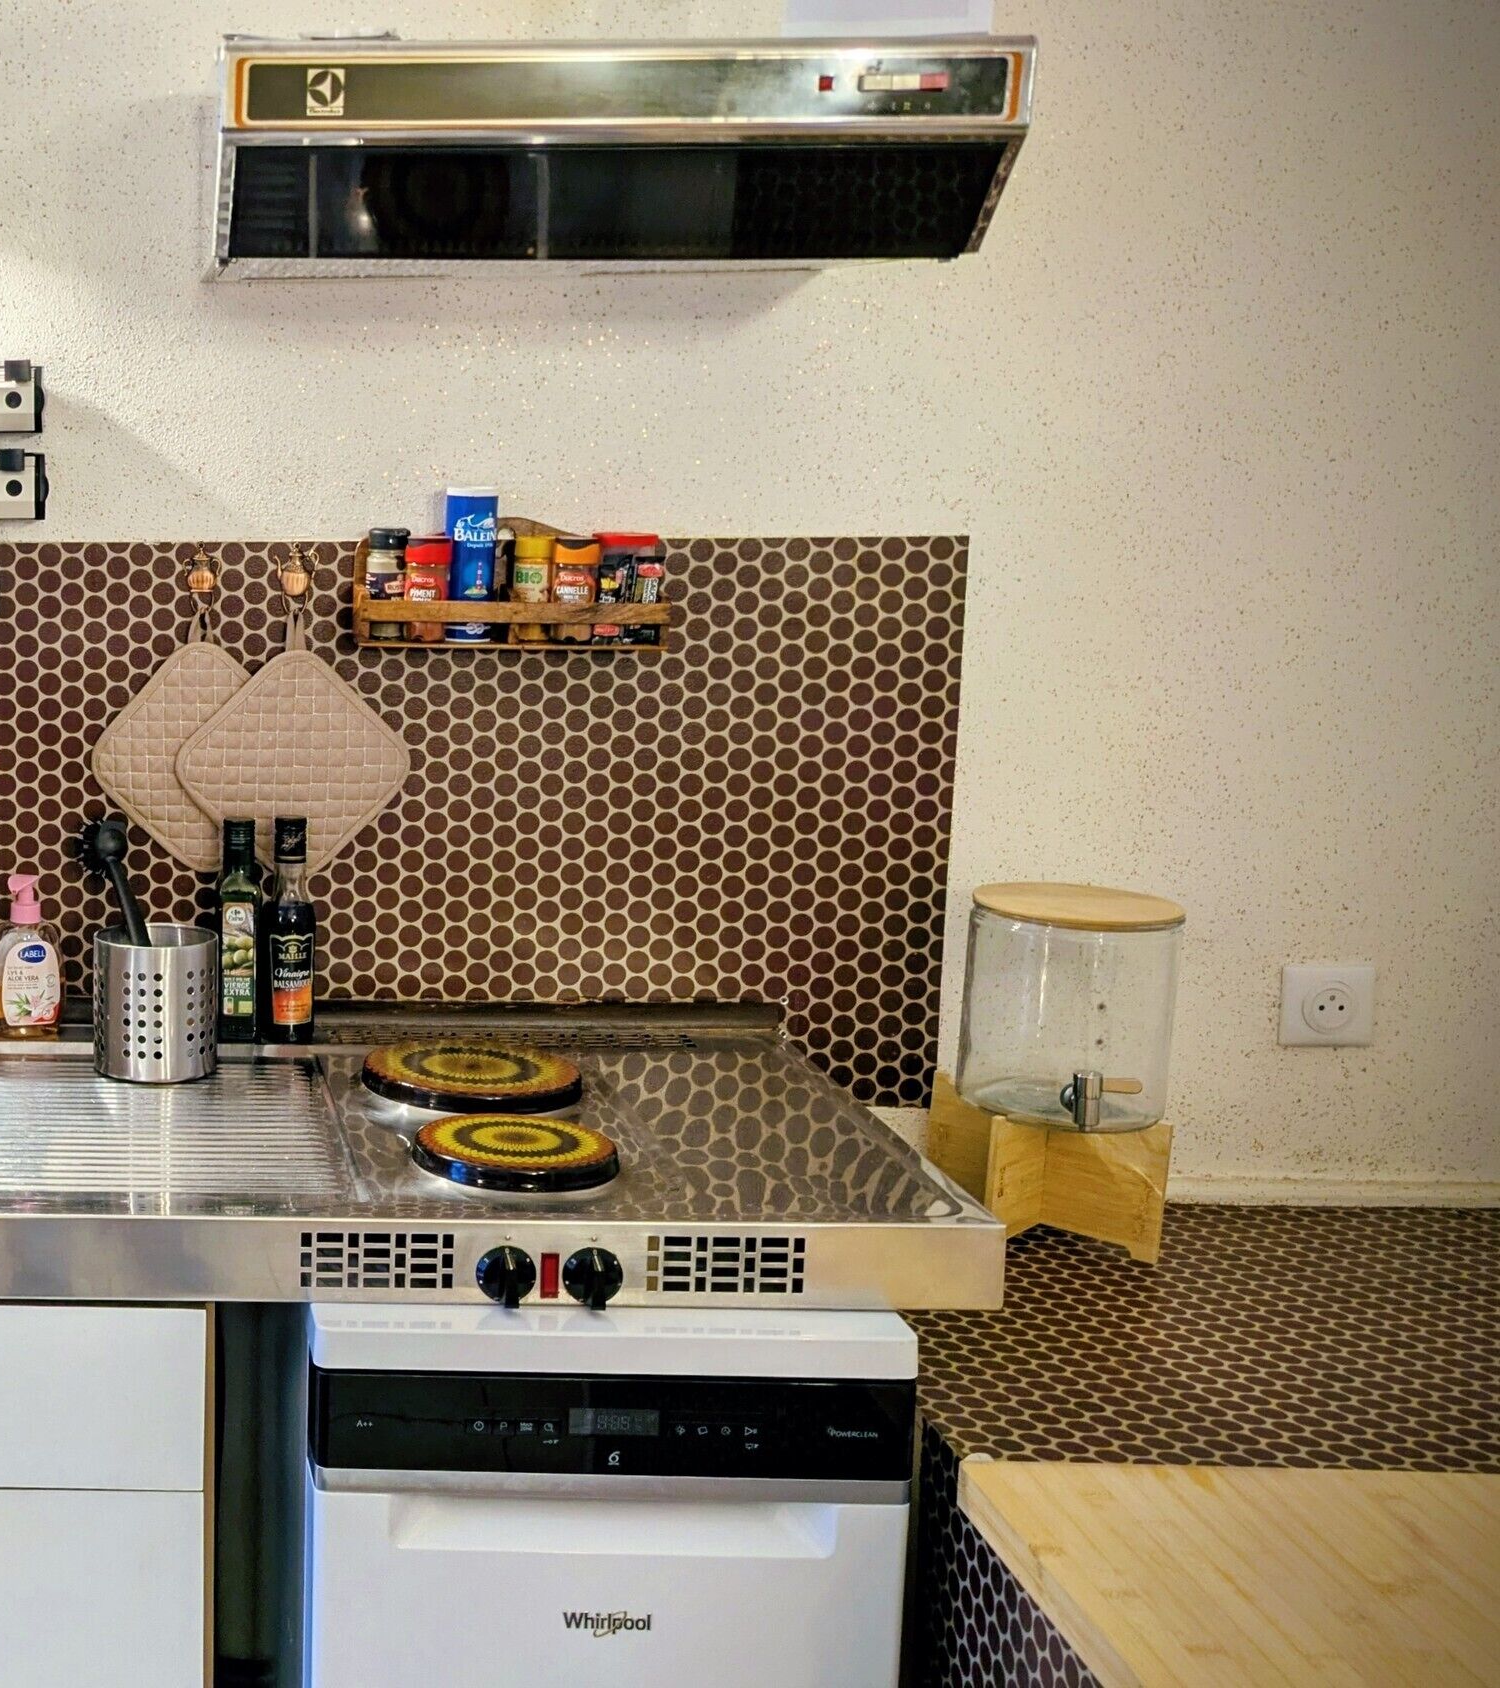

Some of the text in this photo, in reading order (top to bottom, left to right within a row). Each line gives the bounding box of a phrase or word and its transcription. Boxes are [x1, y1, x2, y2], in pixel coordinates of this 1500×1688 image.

[454, 527, 497, 542] BALEIN
[411, 575, 435, 583] Ducros
[560, 573, 585, 582] Ducros
[409, 588, 436, 598] PIMENT
[556, 586, 589, 595] CANNELLE
[20, 949, 45, 958] LABELL
[278, 952, 307, 960] MAILLE
[356, 1419, 373, 1428] A++
[562, 1611, 652, 1635] Whirlpool
